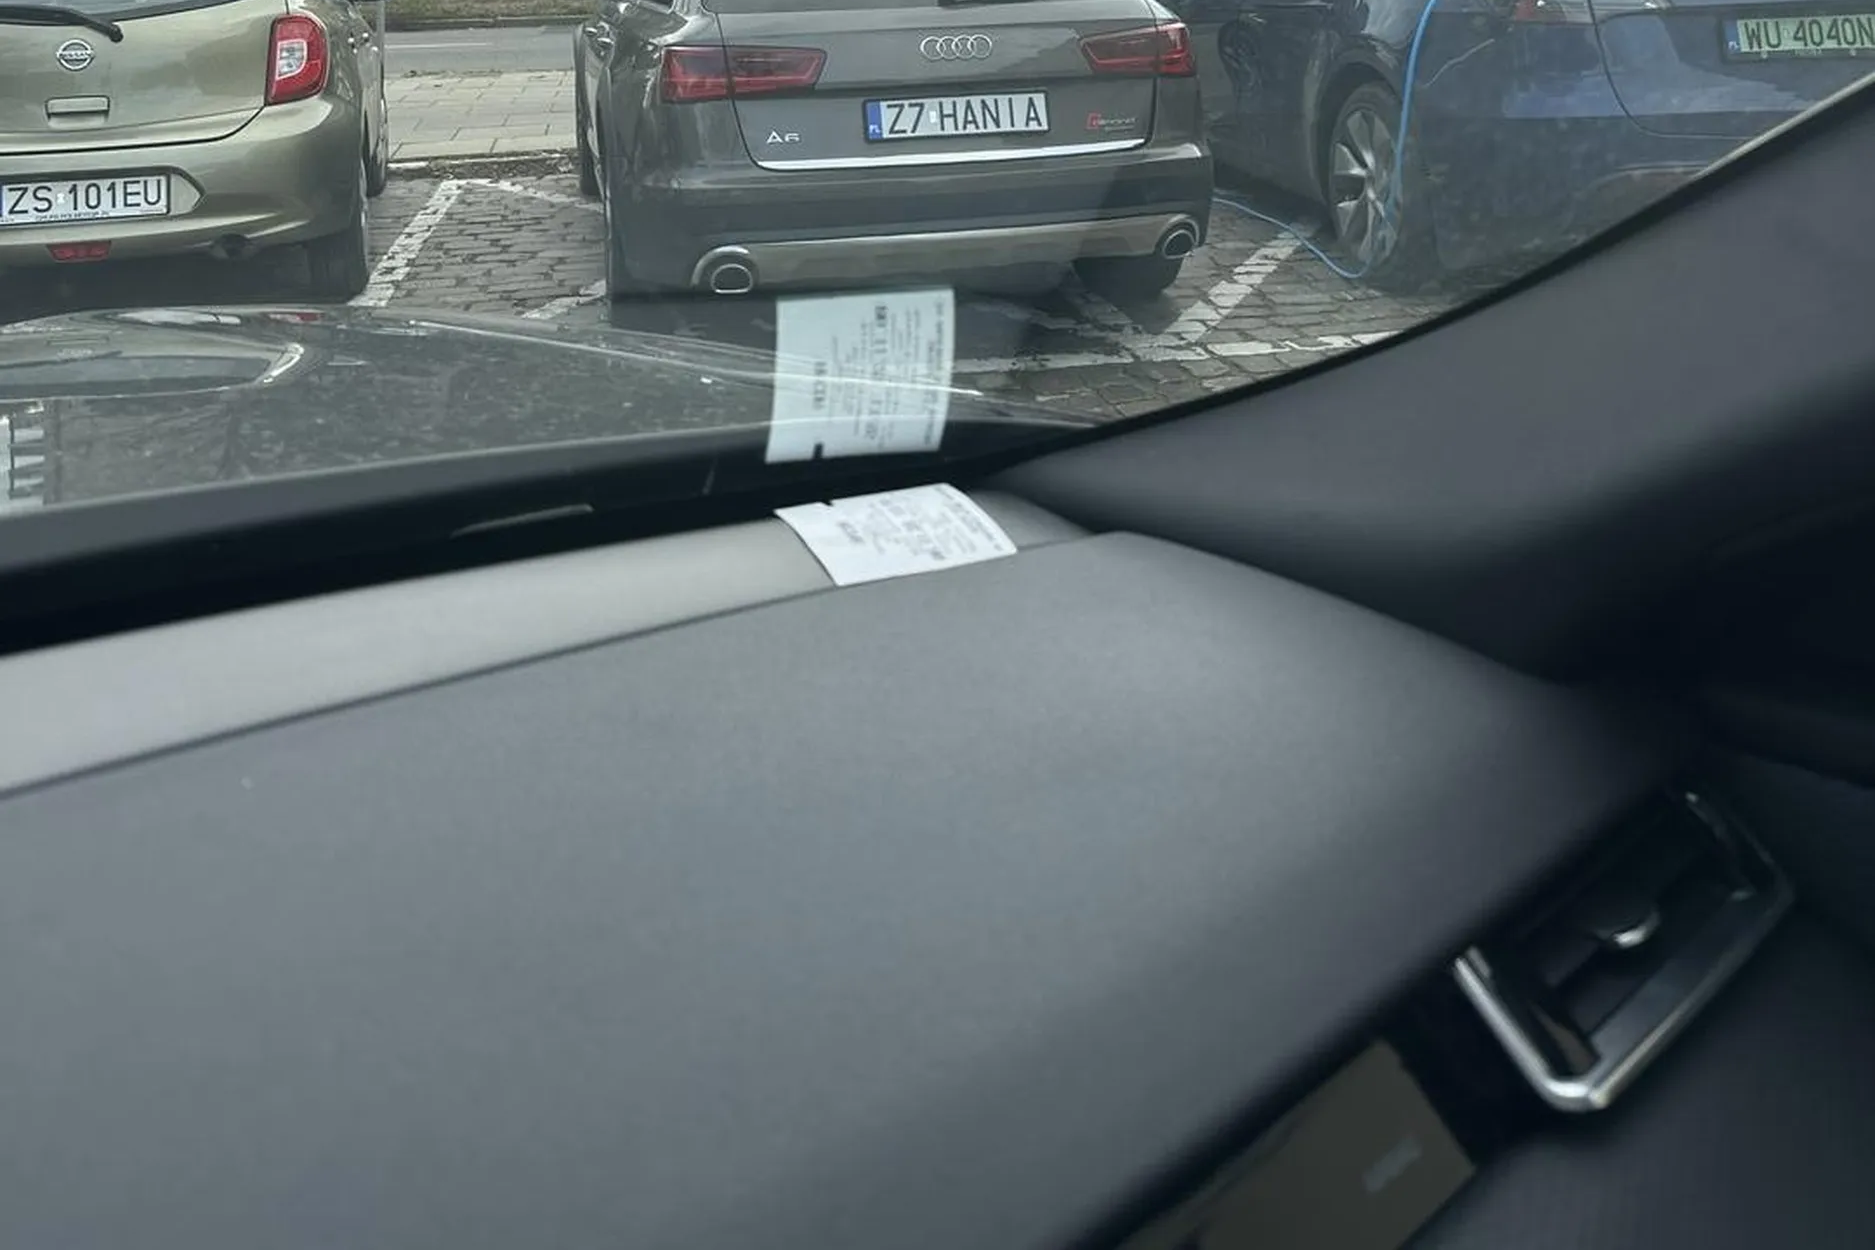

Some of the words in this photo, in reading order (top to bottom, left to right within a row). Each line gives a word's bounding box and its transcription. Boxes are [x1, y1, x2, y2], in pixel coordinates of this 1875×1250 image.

[1744, 21, 1781, 49] WU
[1793, 17, 1875, 47] 4040N
[886, 103, 926, 135] Z7
[938, 96, 1043, 132] HANIA
[766, 131, 800, 144] A6
[8, 185, 53, 215] ZS
[68, 178, 162, 211] 101EU
